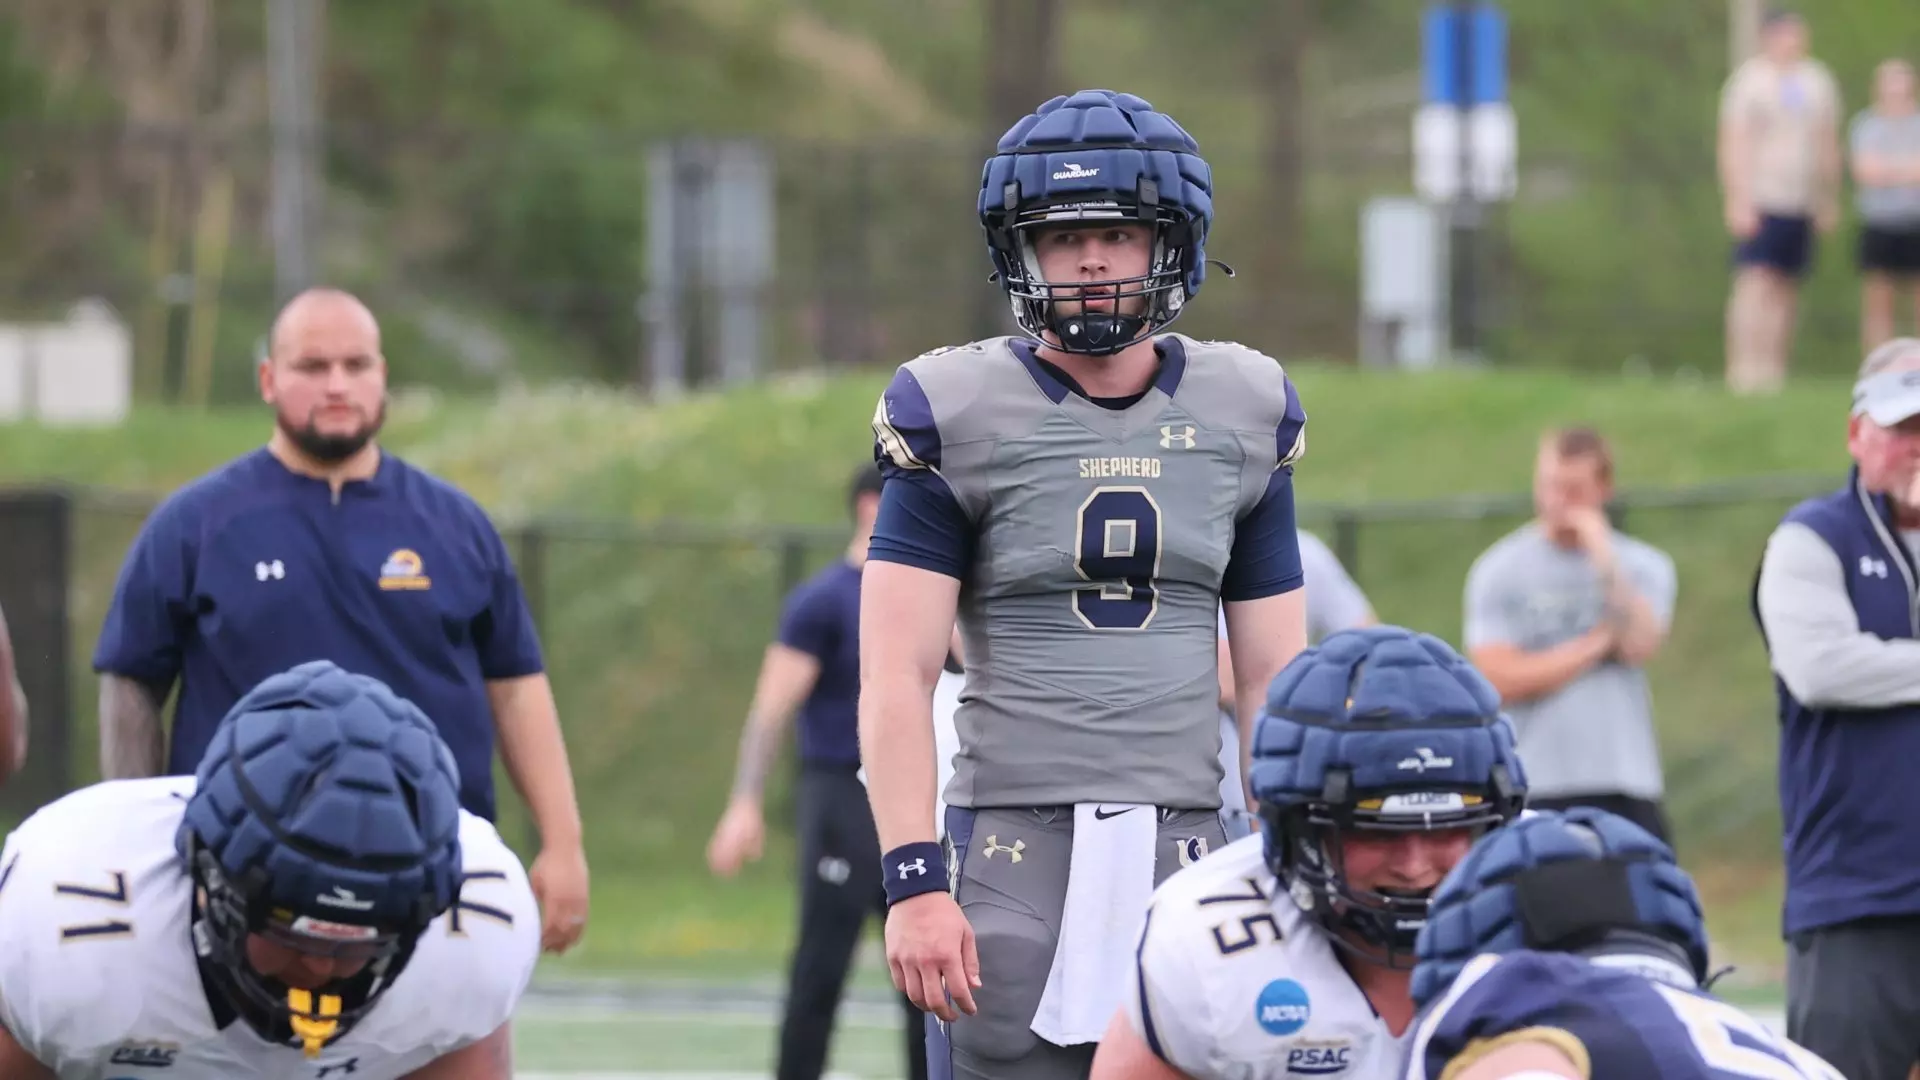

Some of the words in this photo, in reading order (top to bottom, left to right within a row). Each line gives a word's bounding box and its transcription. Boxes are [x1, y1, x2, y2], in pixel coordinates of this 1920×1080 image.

[1053, 168, 1097, 180] GUARDIAN
[1078, 457, 1161, 479] SHEPHERD
[1072, 486, 1162, 630] 9
[53, 869, 137, 944] 71
[1196, 876, 1283, 956] 75
[1287, 1046, 1351, 1065] PSAC
